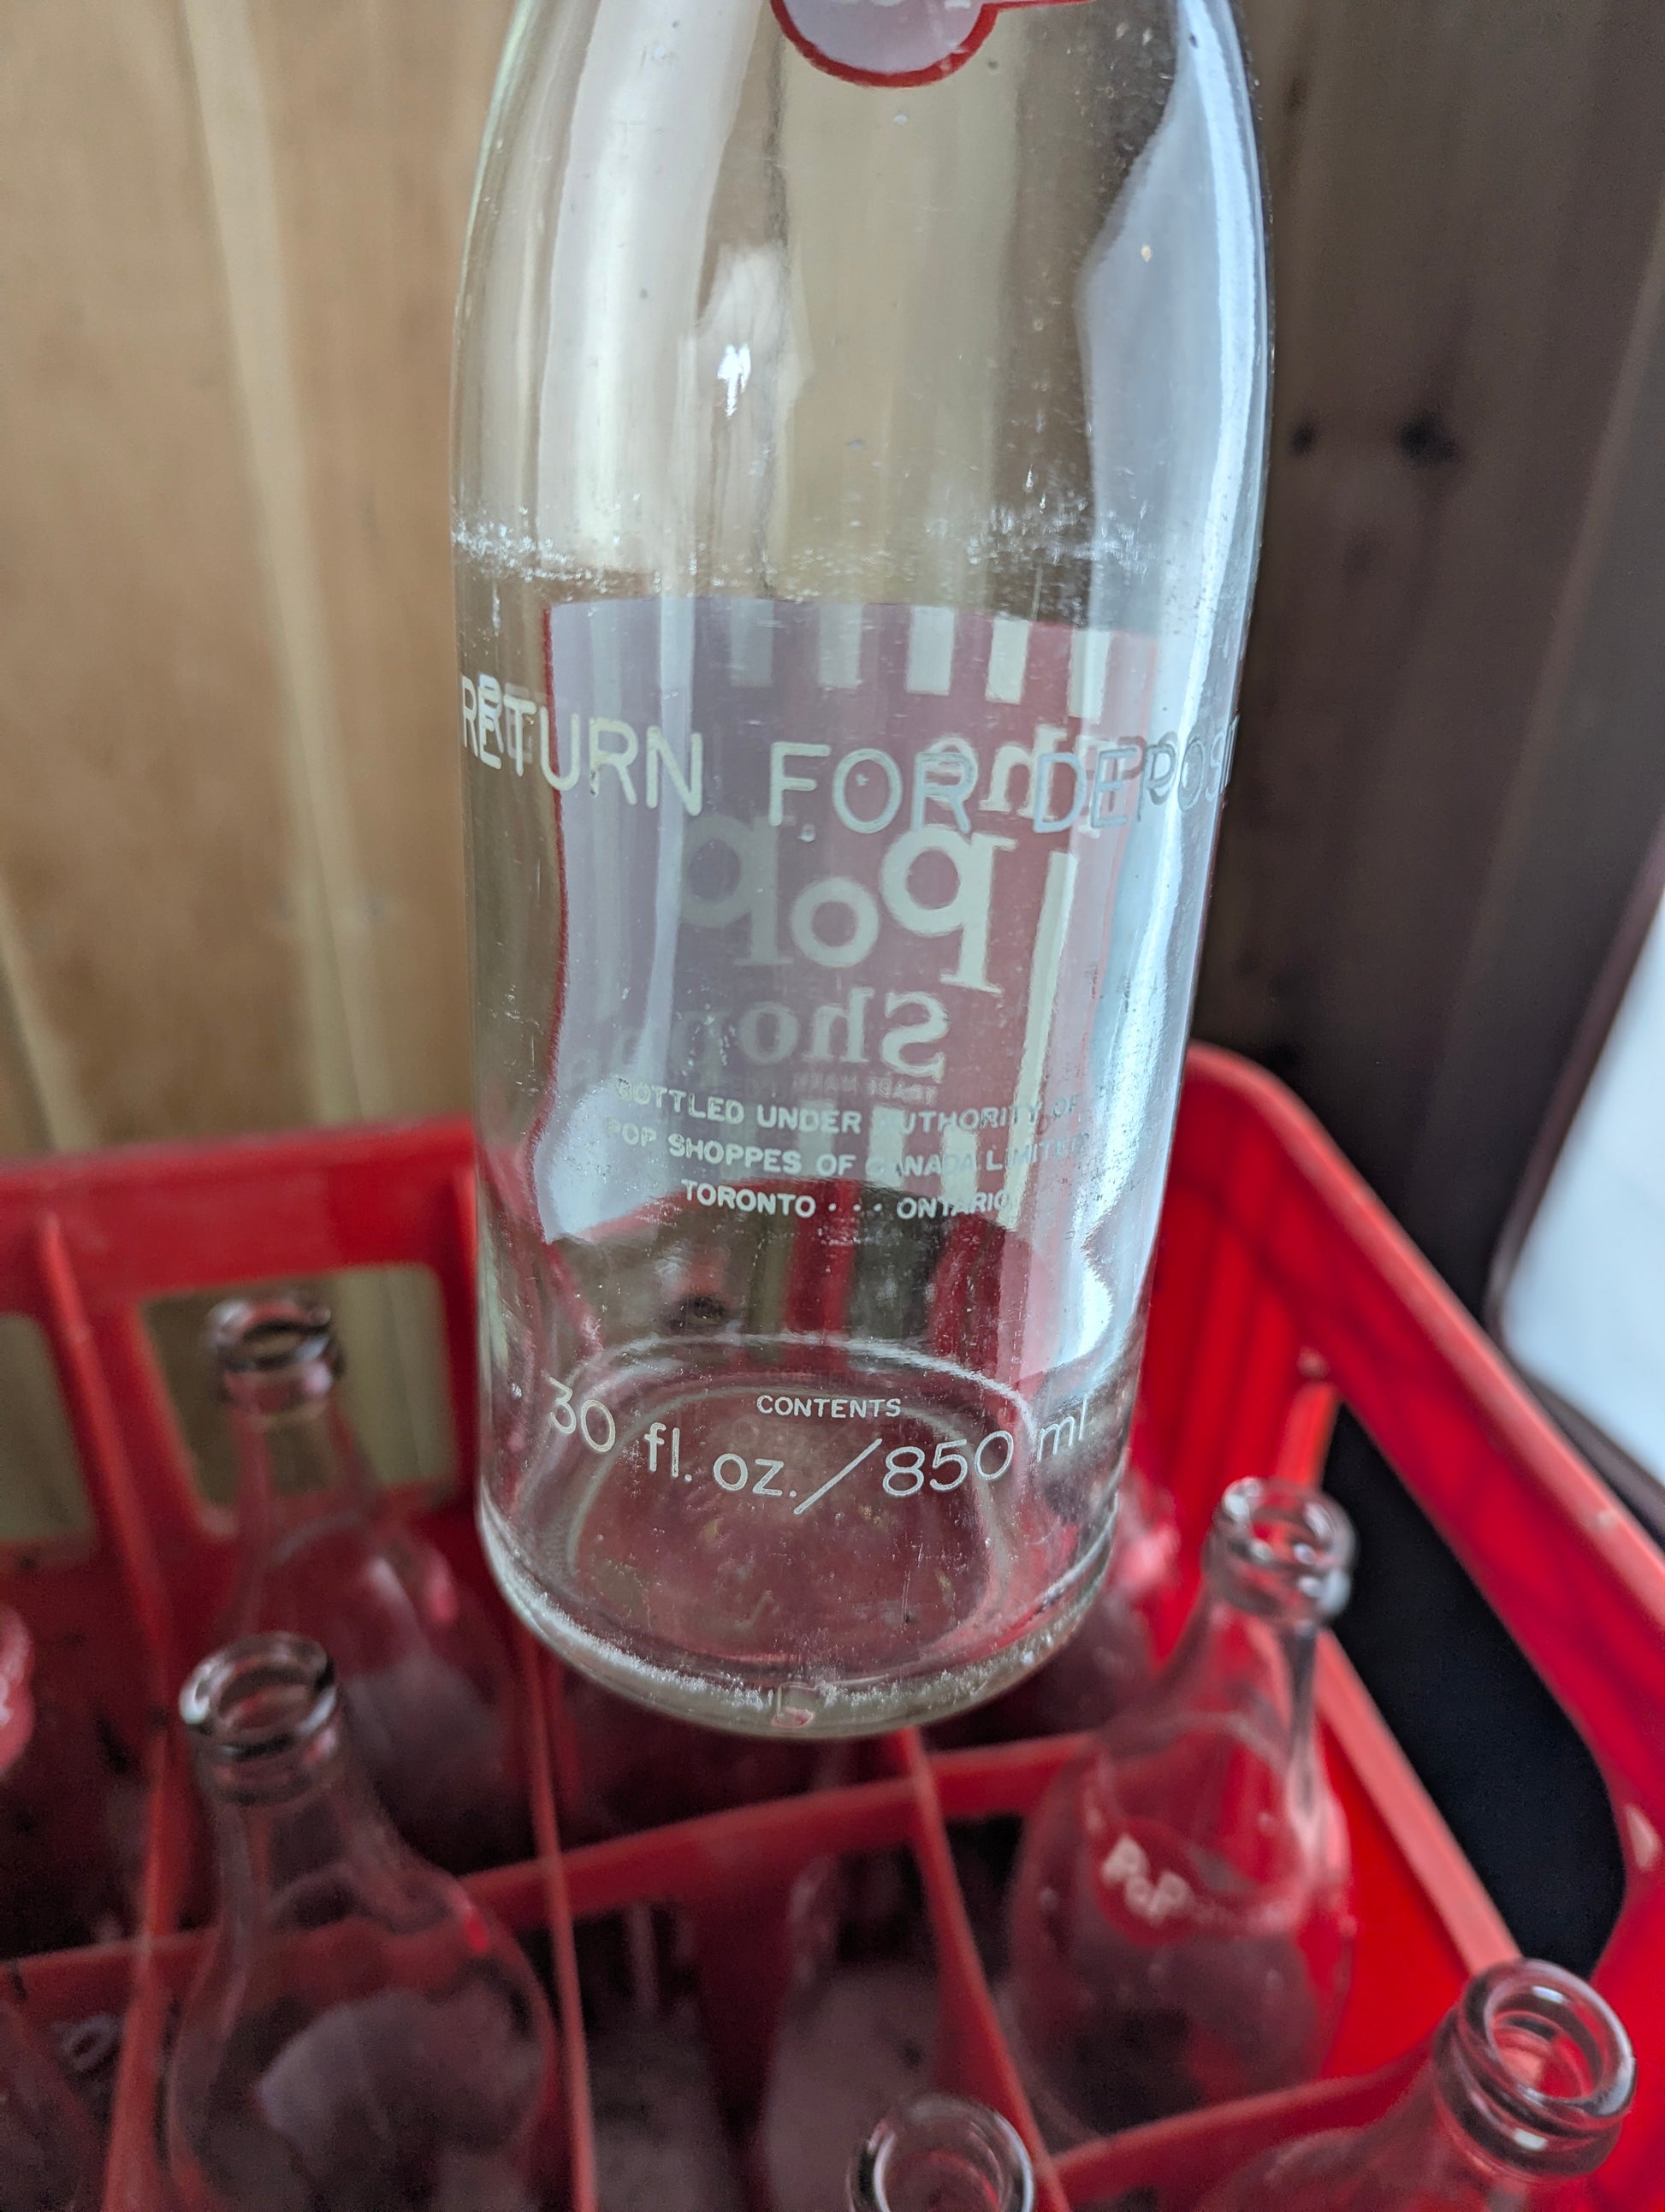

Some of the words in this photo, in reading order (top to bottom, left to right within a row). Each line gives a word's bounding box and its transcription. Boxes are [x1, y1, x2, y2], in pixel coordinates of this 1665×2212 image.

[461, 674, 703, 817] RETURN
[768, 741, 973, 835] FOR
[615, 1076, 745, 1125] BOTTLED
[756, 1104, 862, 1135] UNDER
[874, 1101, 1041, 1136] UTHORITY
[604, 1117, 657, 1148] POP
[668, 1132, 803, 1175] SHOPPES
[815, 1153, 857, 1177] OF
[681, 1178, 816, 1219] TORONTO
[897, 1190, 1011, 1219] ONTARIO
[548, 1375, 616, 1453] 30
[644, 1421, 693, 1482] fl.
[1037, 1395, 1087, 1462] ml
[755, 1394, 902, 1419] CONTENTS
